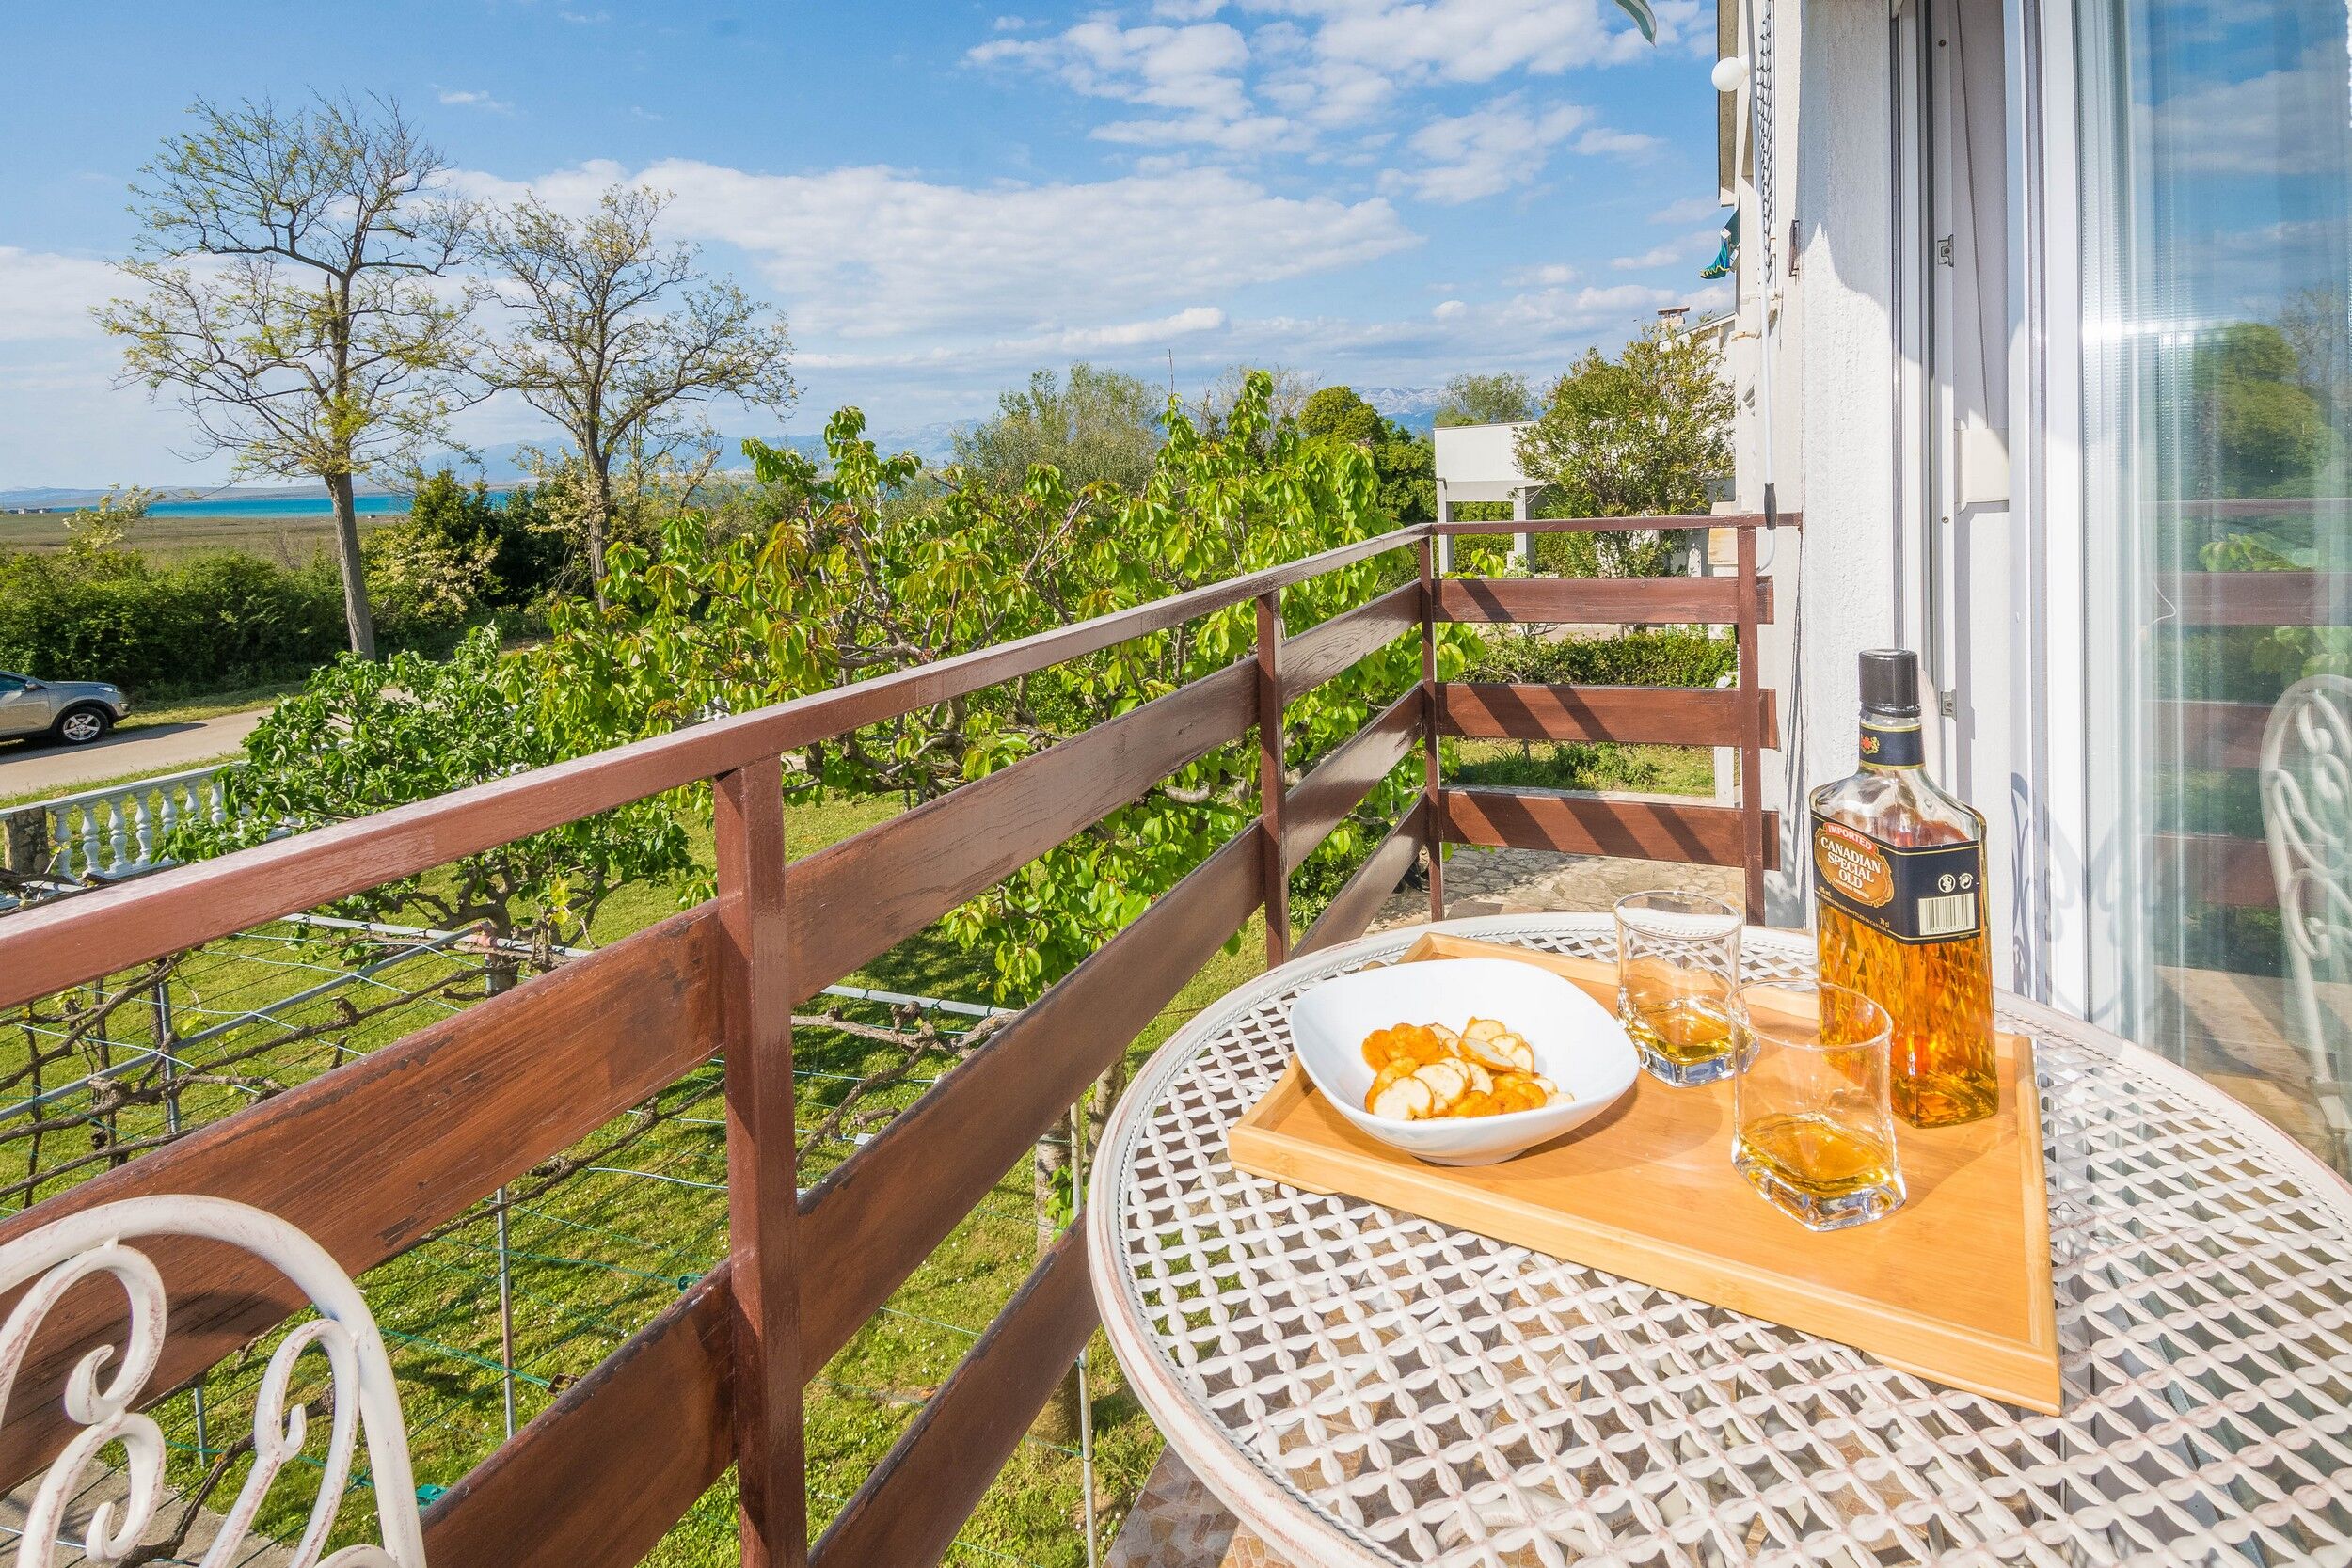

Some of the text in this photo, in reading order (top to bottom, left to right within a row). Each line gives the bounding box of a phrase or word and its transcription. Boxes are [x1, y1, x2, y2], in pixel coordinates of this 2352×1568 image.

[1828, 825, 1872, 850] IMPORTED
[1820, 836, 1882, 873] CANADIAN
[1828, 851, 1874, 883] SPECIAL
[1839, 869, 1863, 889] OLD
